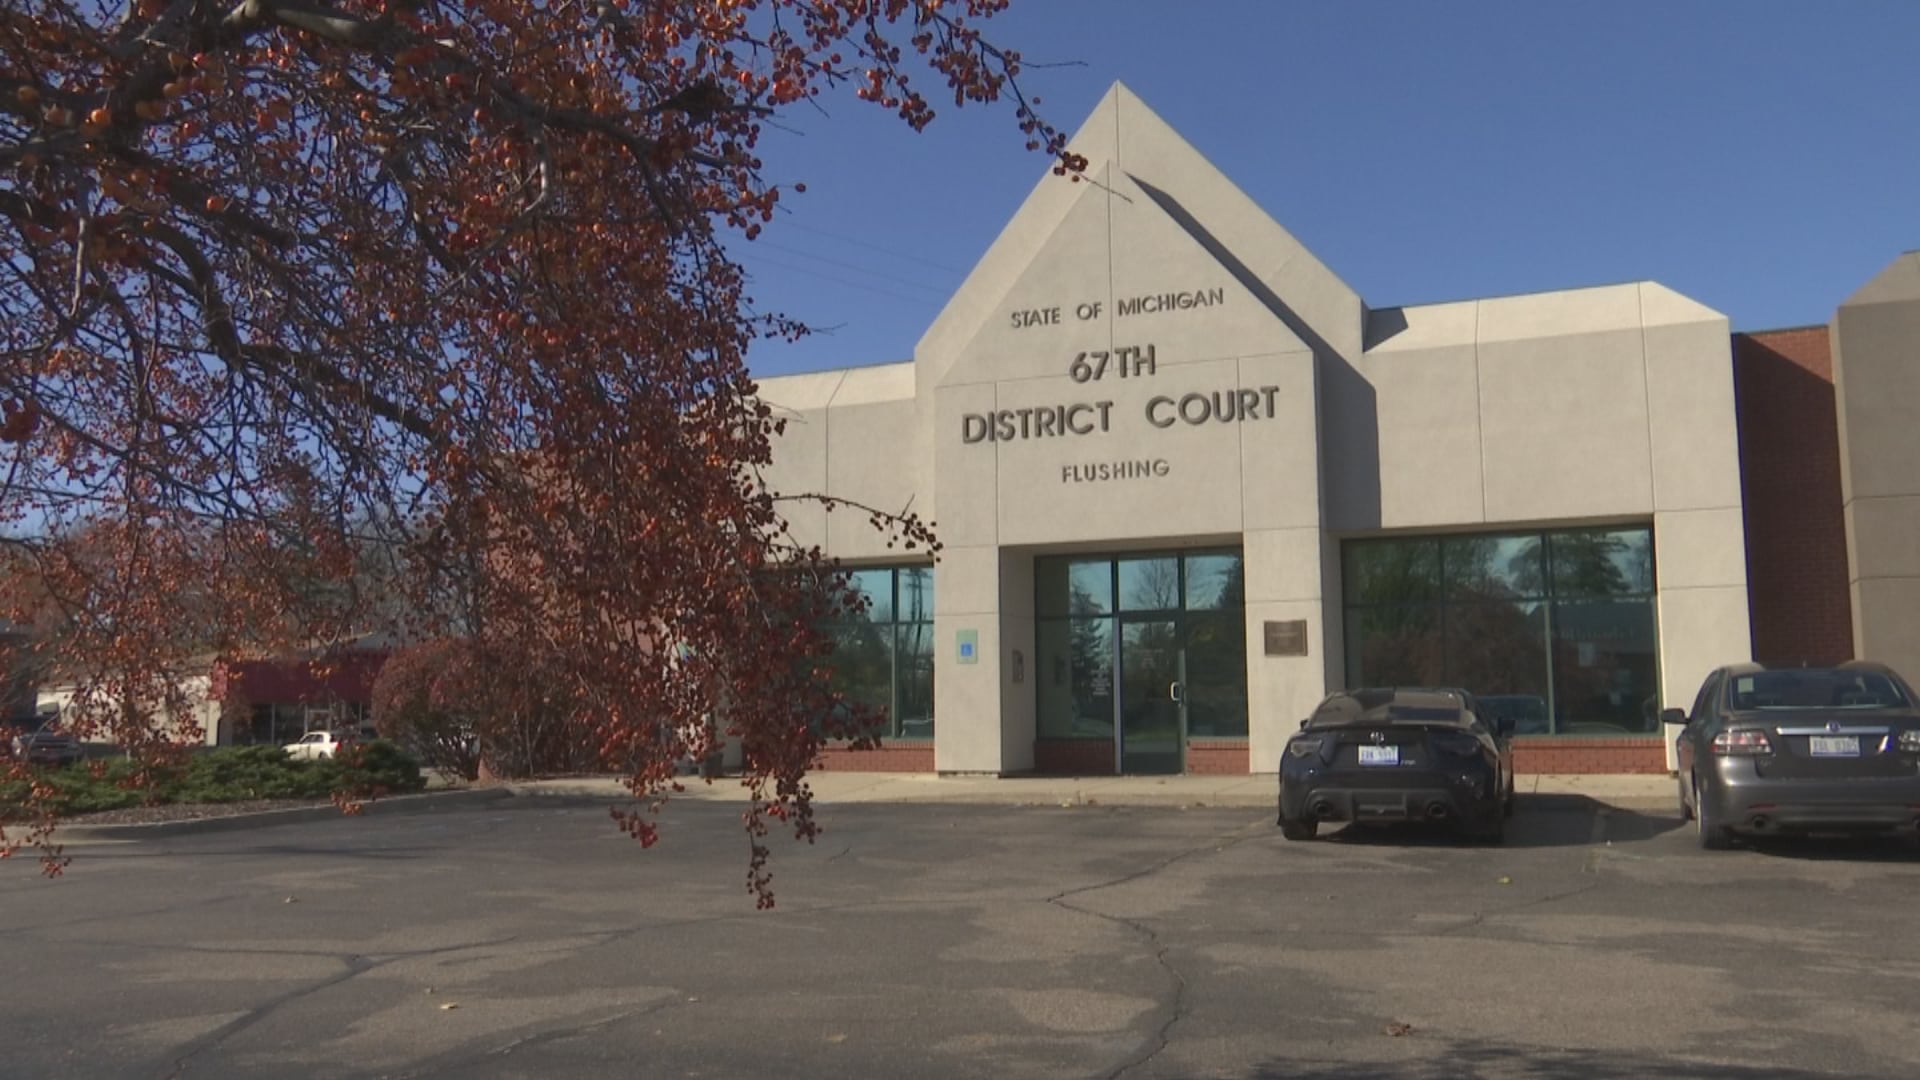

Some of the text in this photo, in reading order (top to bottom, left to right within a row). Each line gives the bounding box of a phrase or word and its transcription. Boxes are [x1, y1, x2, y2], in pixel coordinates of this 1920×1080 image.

[1011, 288, 1224, 328] STATE OF MICHIGAN
[1069, 344, 1156, 383] 67TH
[962, 386, 1280, 444] DISTRICT COURT
[1062, 459, 1170, 483] FLUSHING
